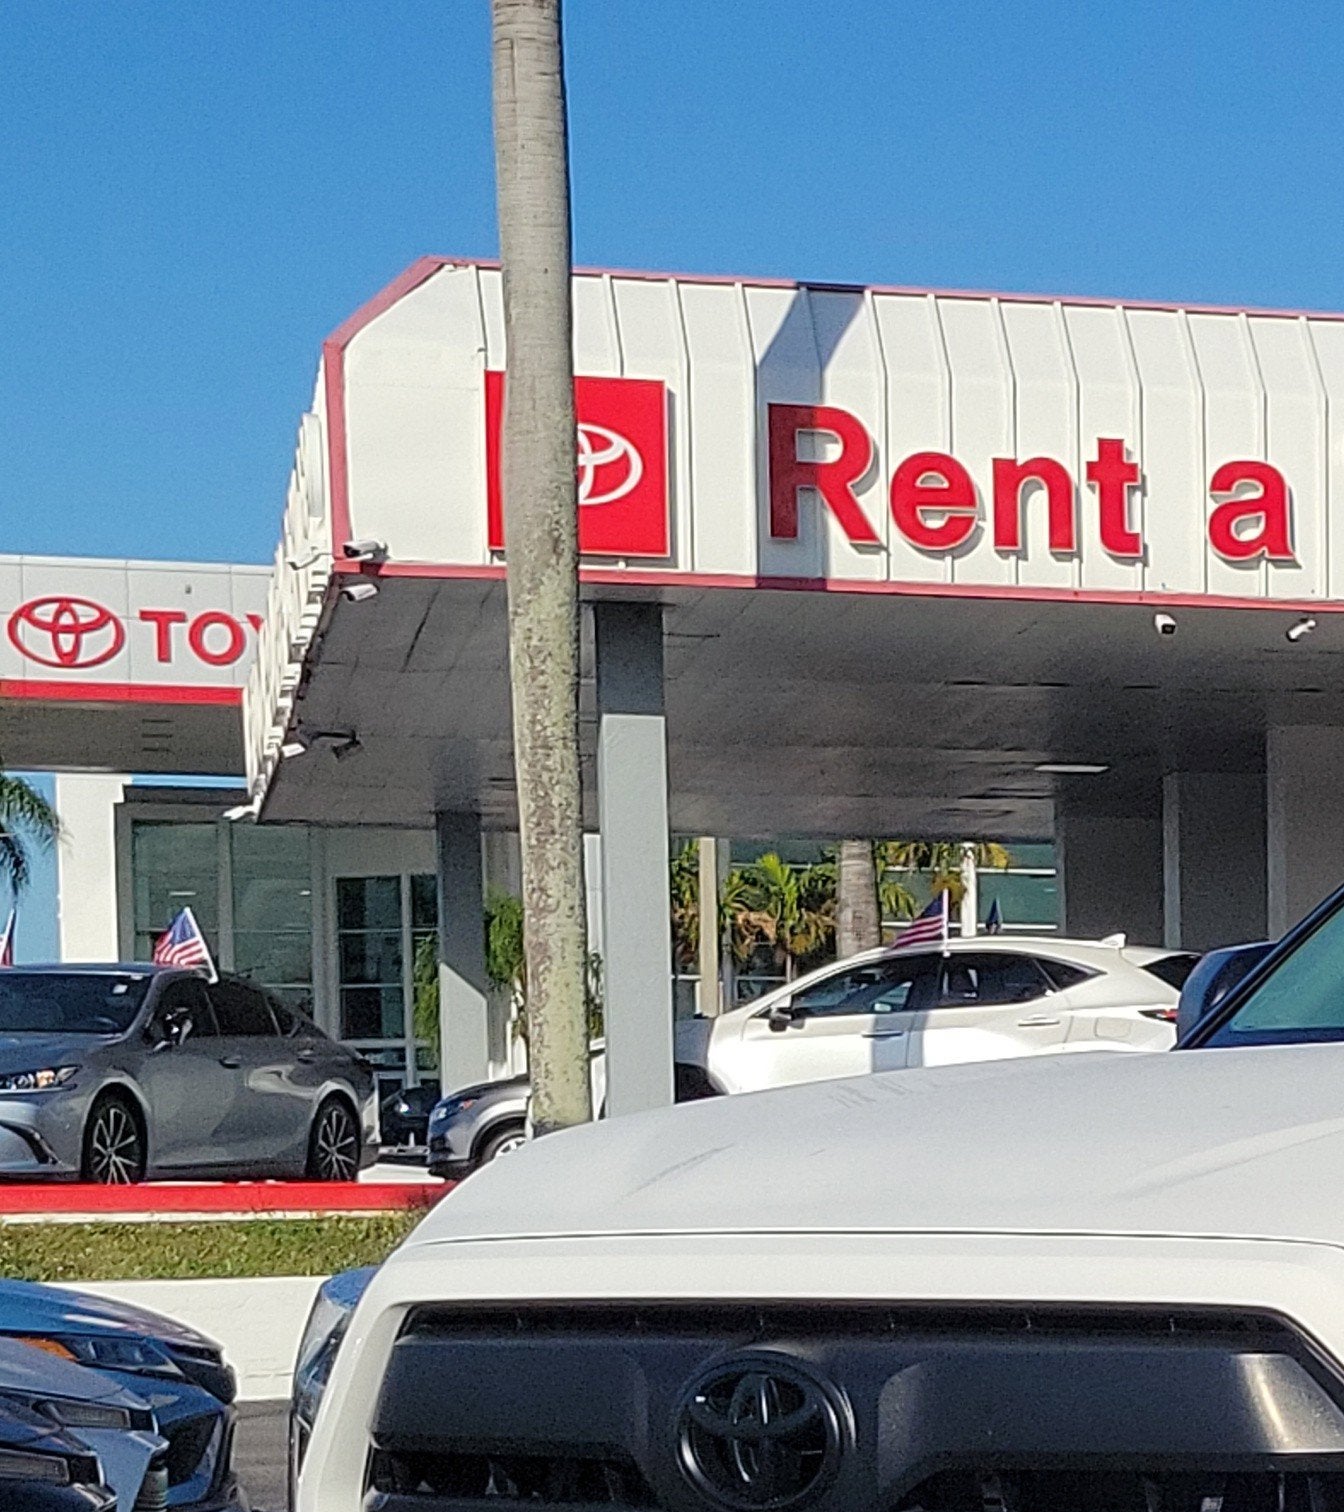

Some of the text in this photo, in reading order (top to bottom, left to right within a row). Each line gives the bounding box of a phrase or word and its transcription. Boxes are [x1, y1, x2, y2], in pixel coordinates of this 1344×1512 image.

[768, 402, 1142, 557] Rent
[1208, 460, 1296, 560] a
[139, 609, 264, 666] TO
